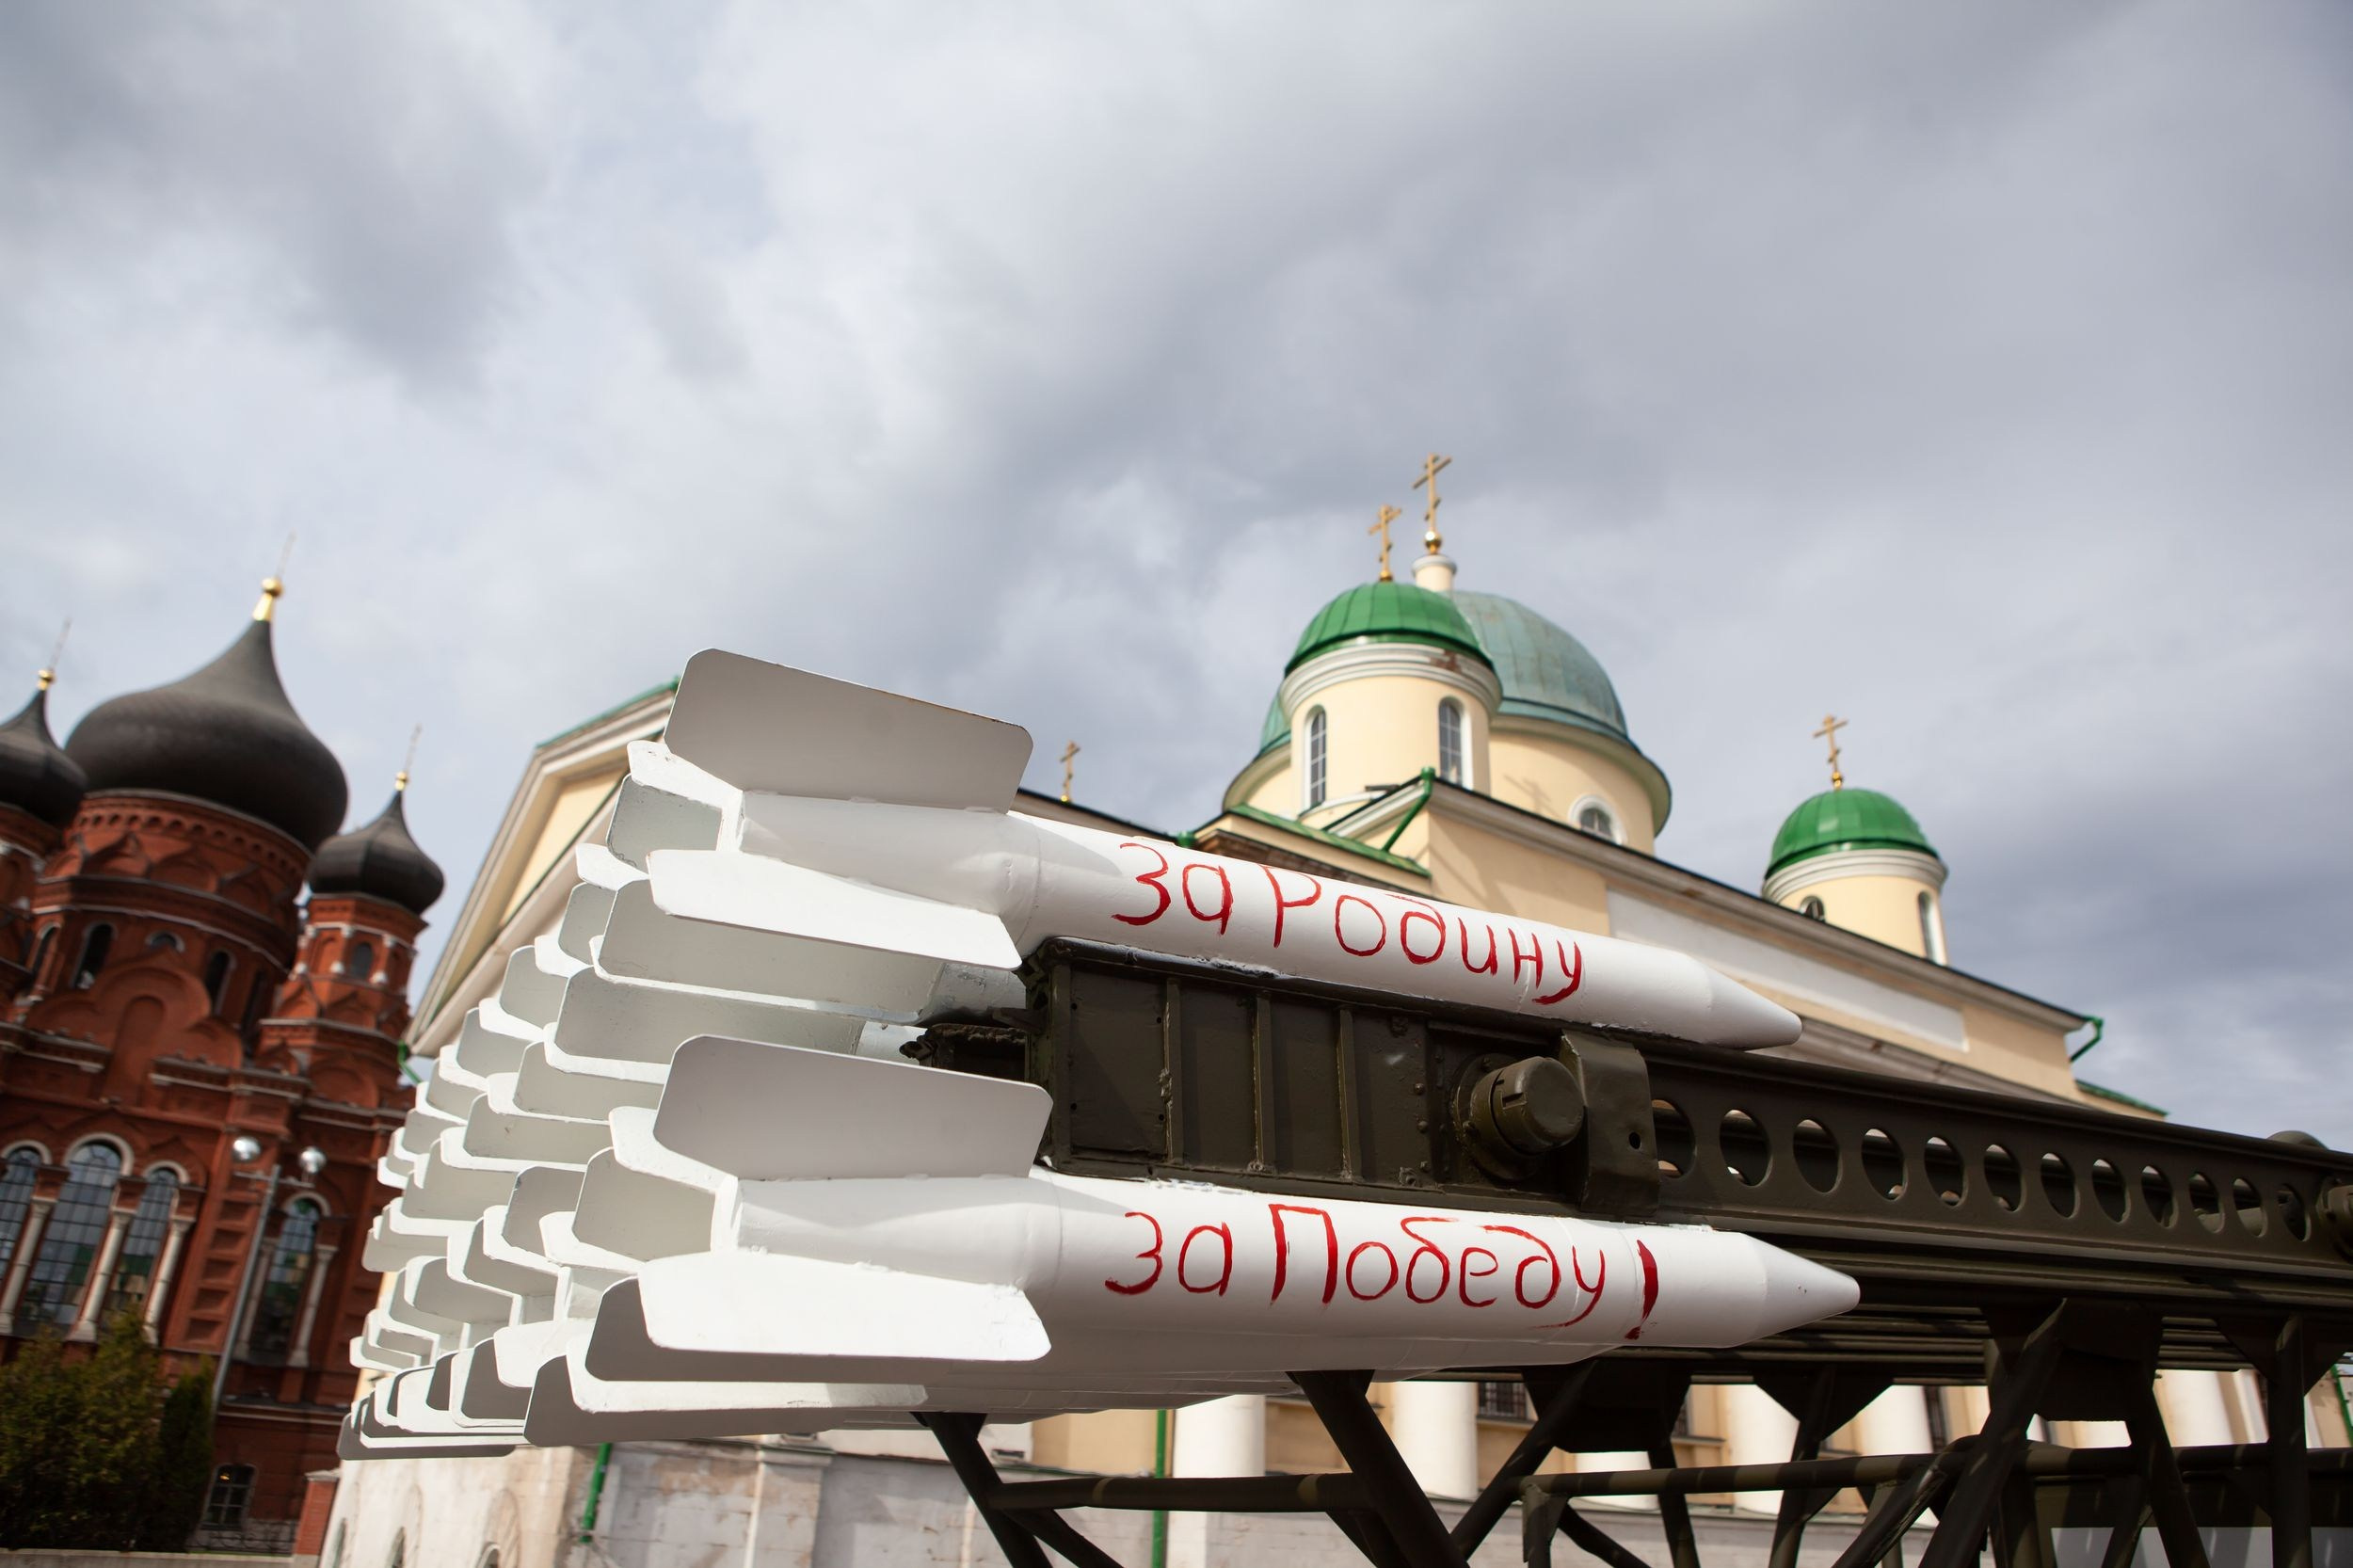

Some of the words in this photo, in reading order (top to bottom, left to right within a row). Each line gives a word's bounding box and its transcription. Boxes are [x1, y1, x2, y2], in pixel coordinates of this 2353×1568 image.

[1111, 842, 1234, 935] За
[1262, 864, 1583, 1005] Родину
[1104, 1210, 1233, 1297] За
[1268, 1203, 1660, 1340] Победу!
